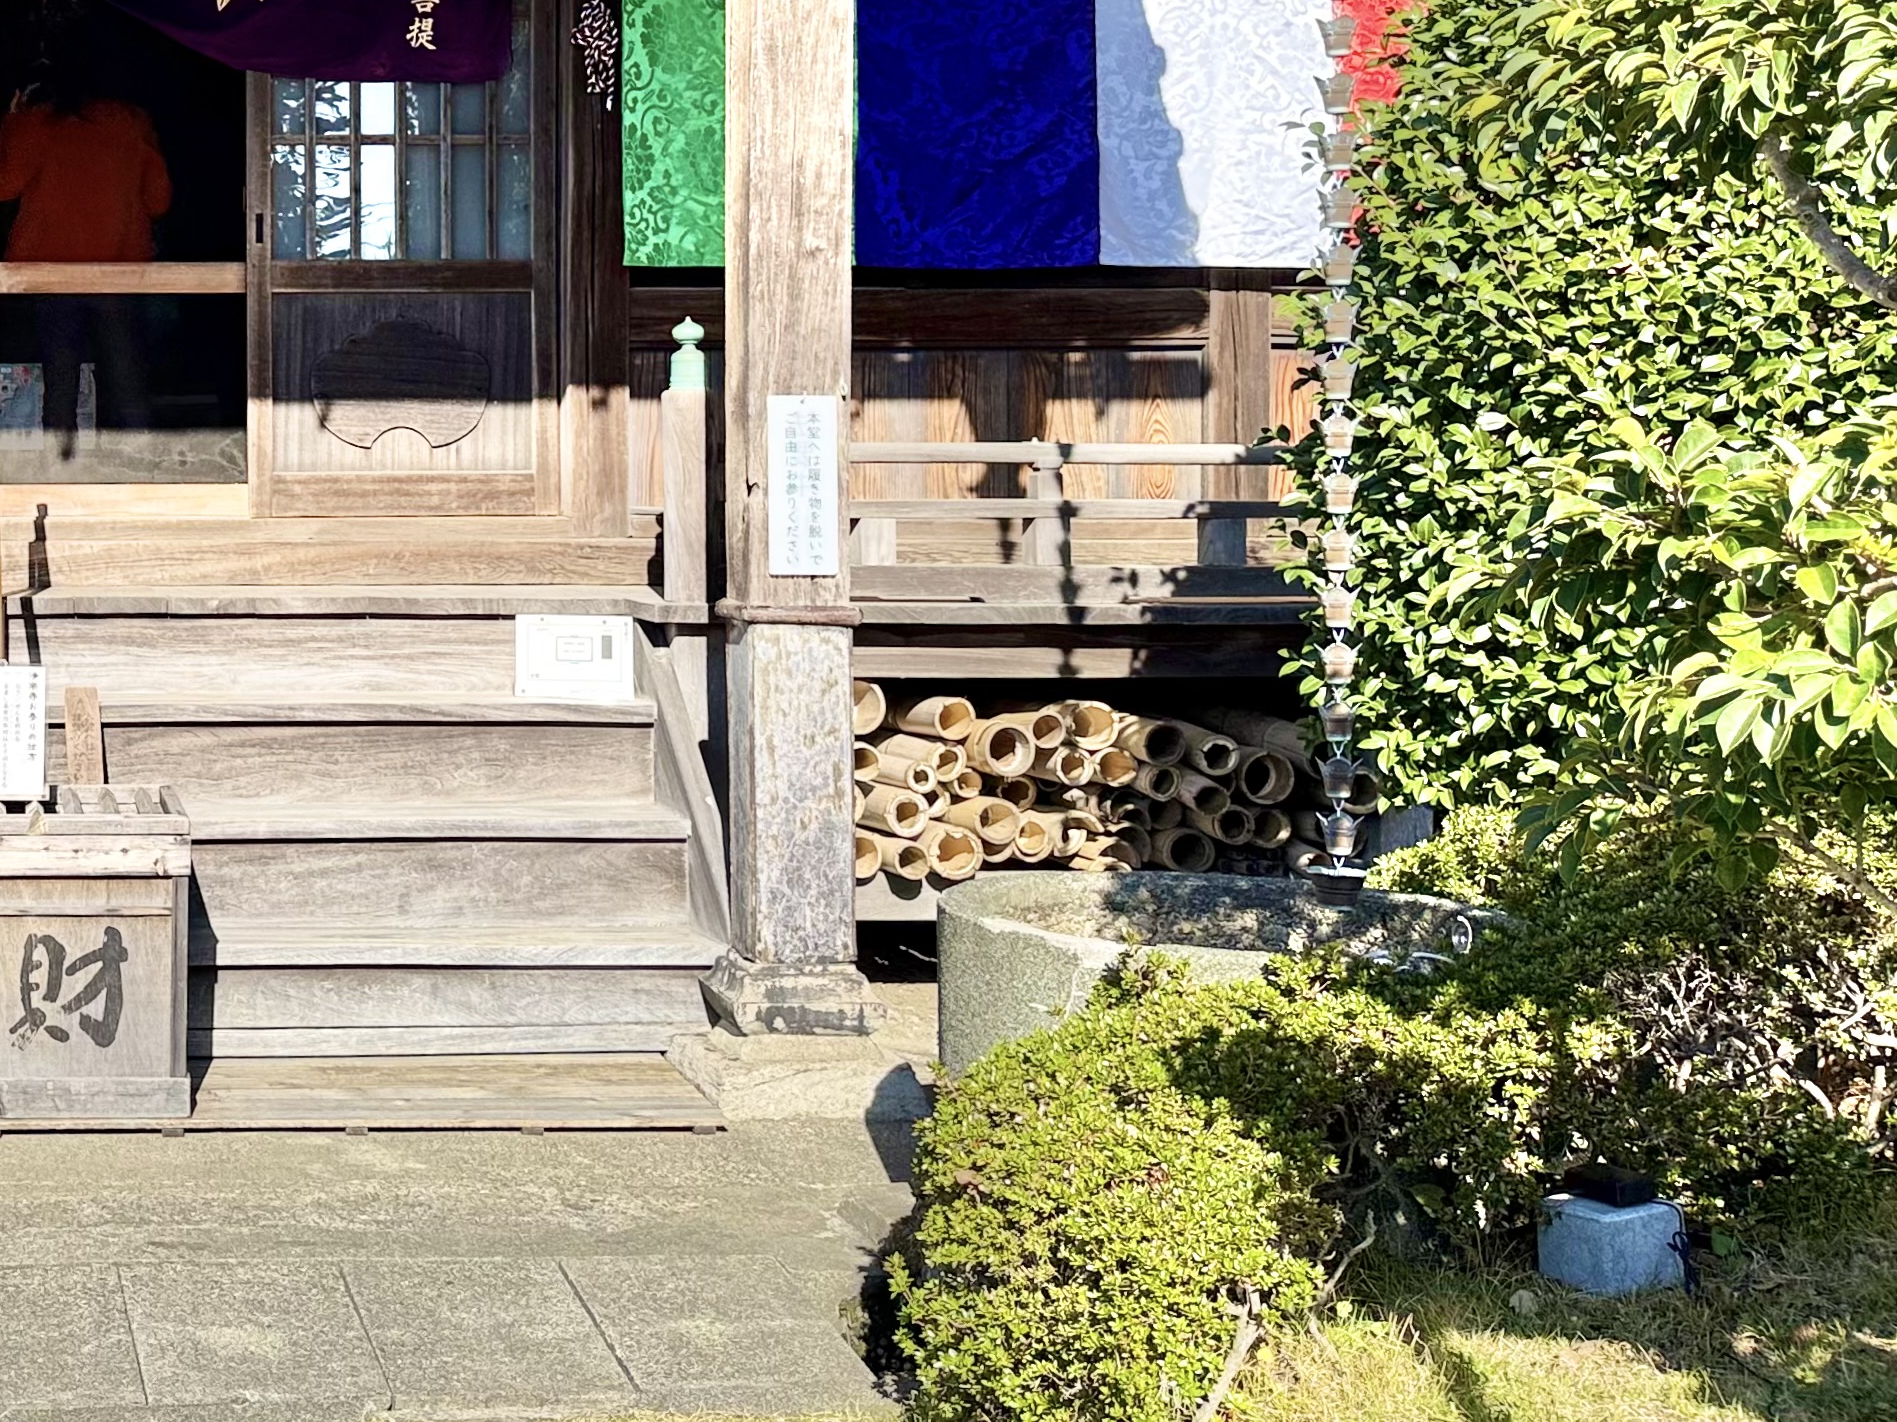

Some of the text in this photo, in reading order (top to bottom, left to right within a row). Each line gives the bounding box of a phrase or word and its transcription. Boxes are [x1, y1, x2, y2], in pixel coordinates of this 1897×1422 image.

[784, 411, 800, 566] ご自由にお参りください
[807, 412, 823, 566] 本堂へは履き物を脱いで
